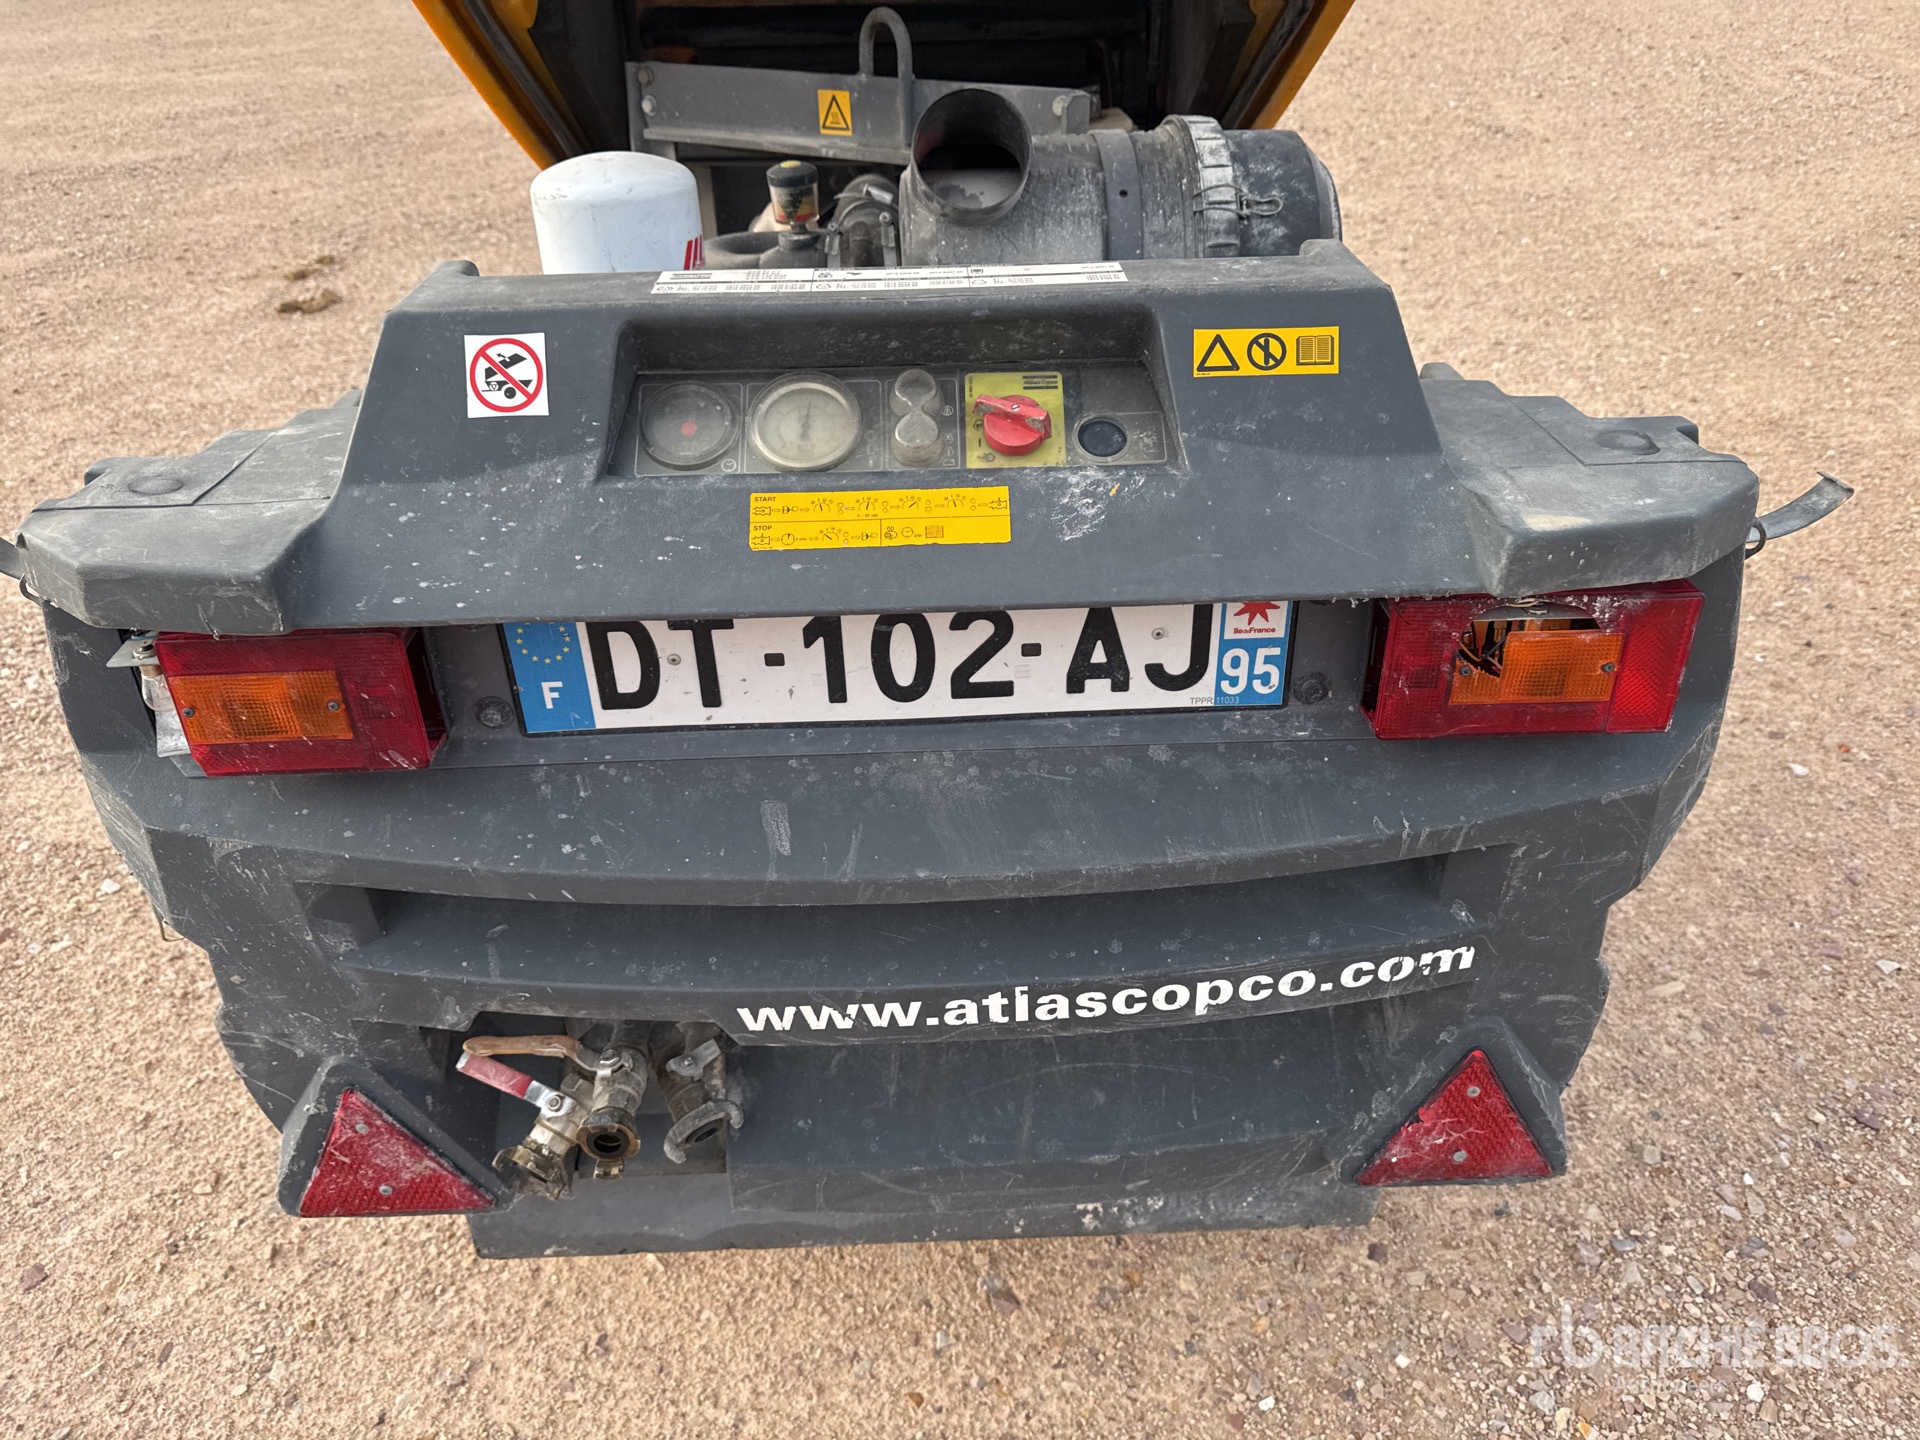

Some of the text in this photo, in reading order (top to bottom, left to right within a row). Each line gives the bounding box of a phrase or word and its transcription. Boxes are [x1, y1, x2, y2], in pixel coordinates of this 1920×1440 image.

[541, 681, 563, 709] F
[1221, 647, 1281, 695] 95
[737, 946, 1476, 1031] www.atlascopco.com
